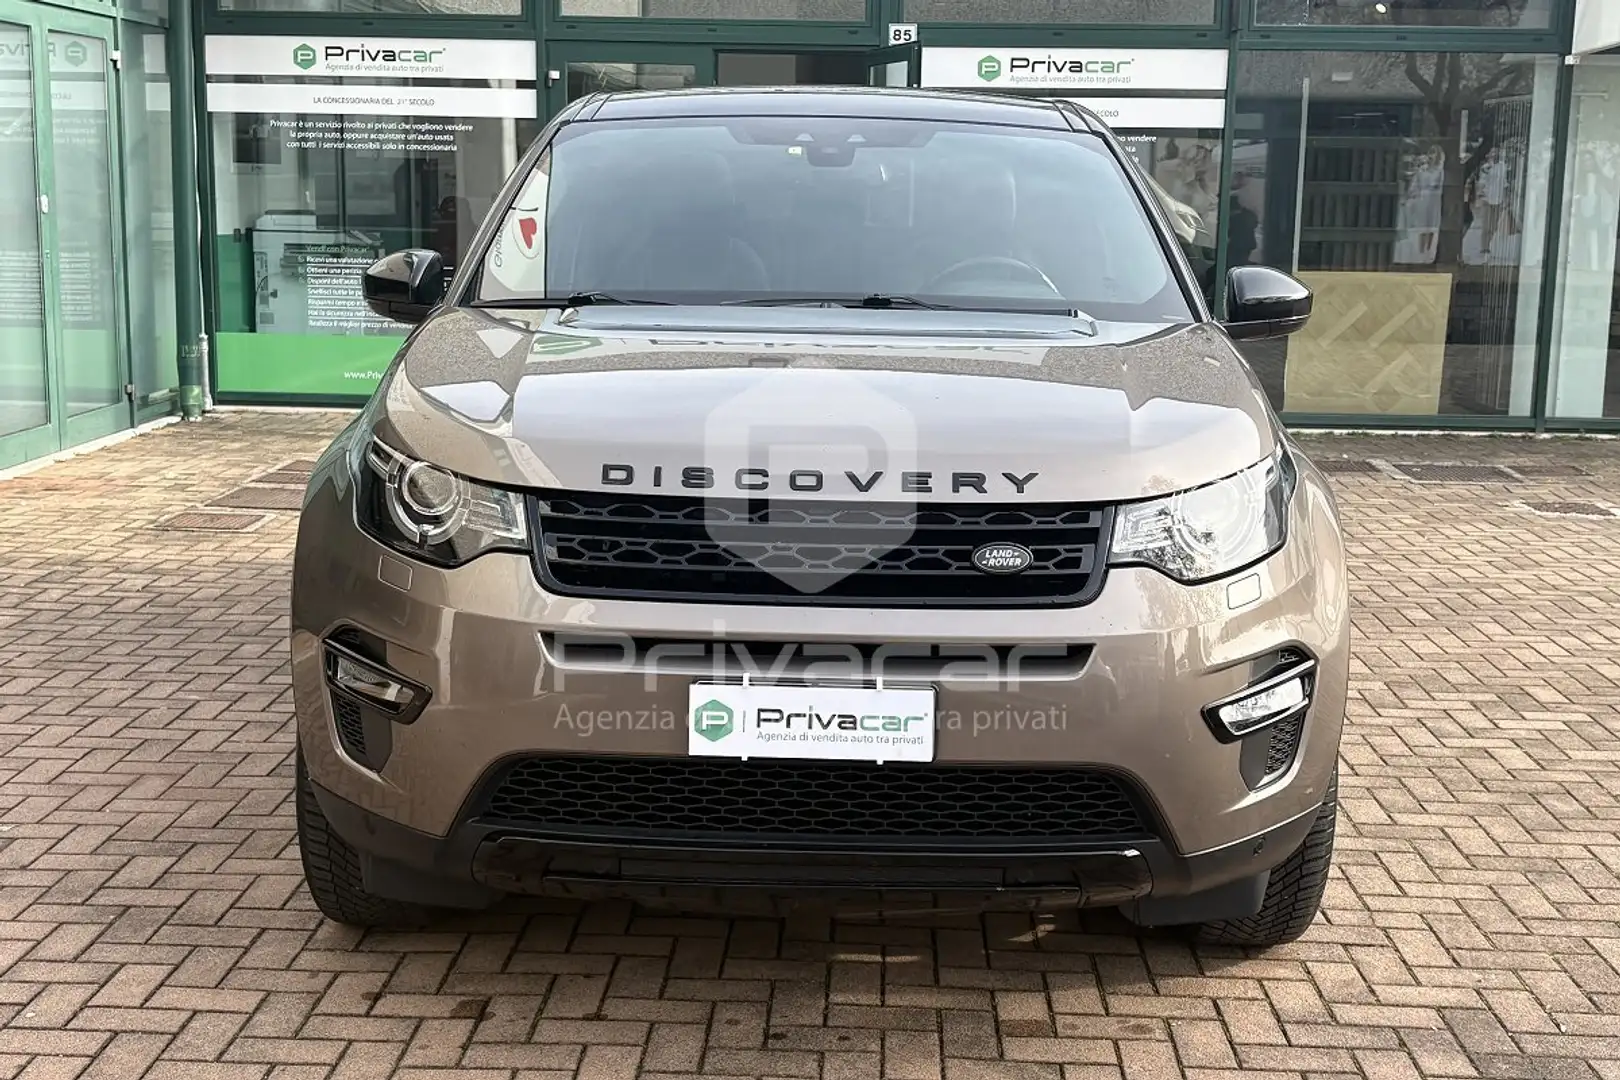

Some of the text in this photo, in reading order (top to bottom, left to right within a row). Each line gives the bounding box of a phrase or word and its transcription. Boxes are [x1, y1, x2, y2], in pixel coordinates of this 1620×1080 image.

[893, 29, 912, 42] 85
[324, 44, 443, 63] Privacar
[325, 63, 354, 73] Agenzia
[355, 64, 363, 72] di
[364, 64, 390, 72] vendita
[421, 66, 444, 74] privati
[1010, 54, 1131, 73] Privacar
[1010, 75, 1039, 84] Agenzia
[1040, 75, 1048, 83] di
[1049, 75, 1076, 83] vendita
[1107, 76, 1131, 84] privati
[313, 96, 322, 104] LA
[322, 97, 380, 105] CONCESSIONARIA
[409, 98, 435, 106] SECOLO
[269, 119, 298, 128] Privacar
[315, 120, 342, 129] servizio
[343, 121, 366, 129] rivolto
[366, 121, 373, 129] ai
[374, 122, 397, 131] privati
[398, 122, 412, 130] che
[411, 122, 443, 132] vogliono
[444, 123, 474, 131] vendere
[289, 130, 296, 138] la
[297, 131, 323, 140] propria
[342, 132, 368, 141] oppure
[369, 132, 406, 141] acquistare
[434, 134, 454, 142] usata
[1127, 134, 1157, 143] vendere
[301, 140, 317, 149] tutti
[322, 141, 345, 149] servizi
[345, 141, 380, 150] accessibili
[382, 141, 397, 150] solo
[398, 142, 405, 150] in
[405, 143, 458, 151] concessionaria
[344, 370, 385, 380] www.Priv
[601, 463, 1040, 494] DISCOVERY
[756, 706, 925, 733] Privacar
[756, 731, 924, 746] Agenzia di vendita auto tra privati
